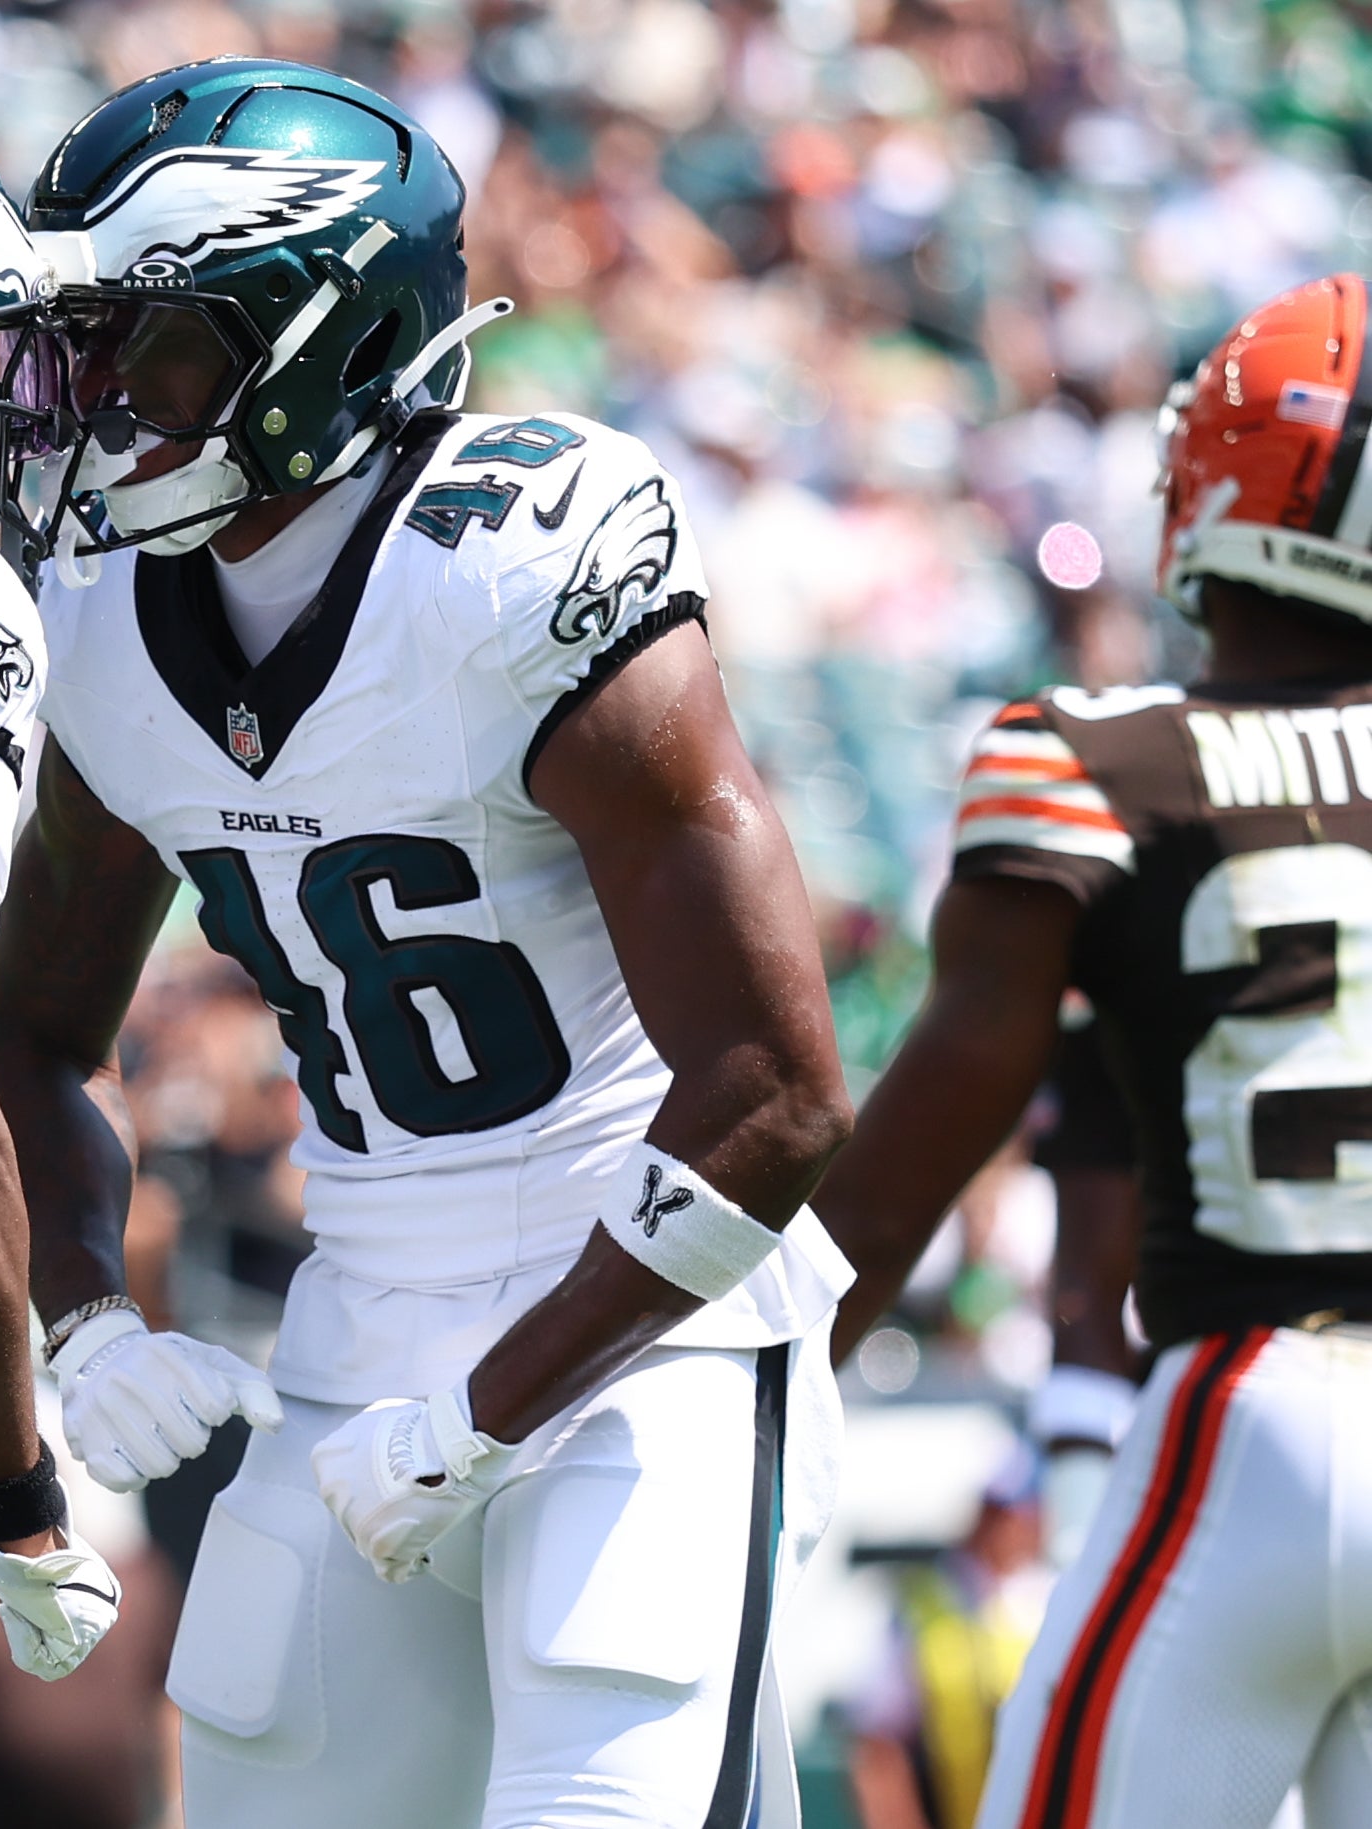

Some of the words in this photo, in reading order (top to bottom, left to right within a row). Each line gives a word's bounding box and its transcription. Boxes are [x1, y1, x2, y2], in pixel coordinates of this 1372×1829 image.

[122, 278, 187, 288] OAKLEY
[404, 416, 588, 551] 46
[218, 809, 323, 838] EAGLES
